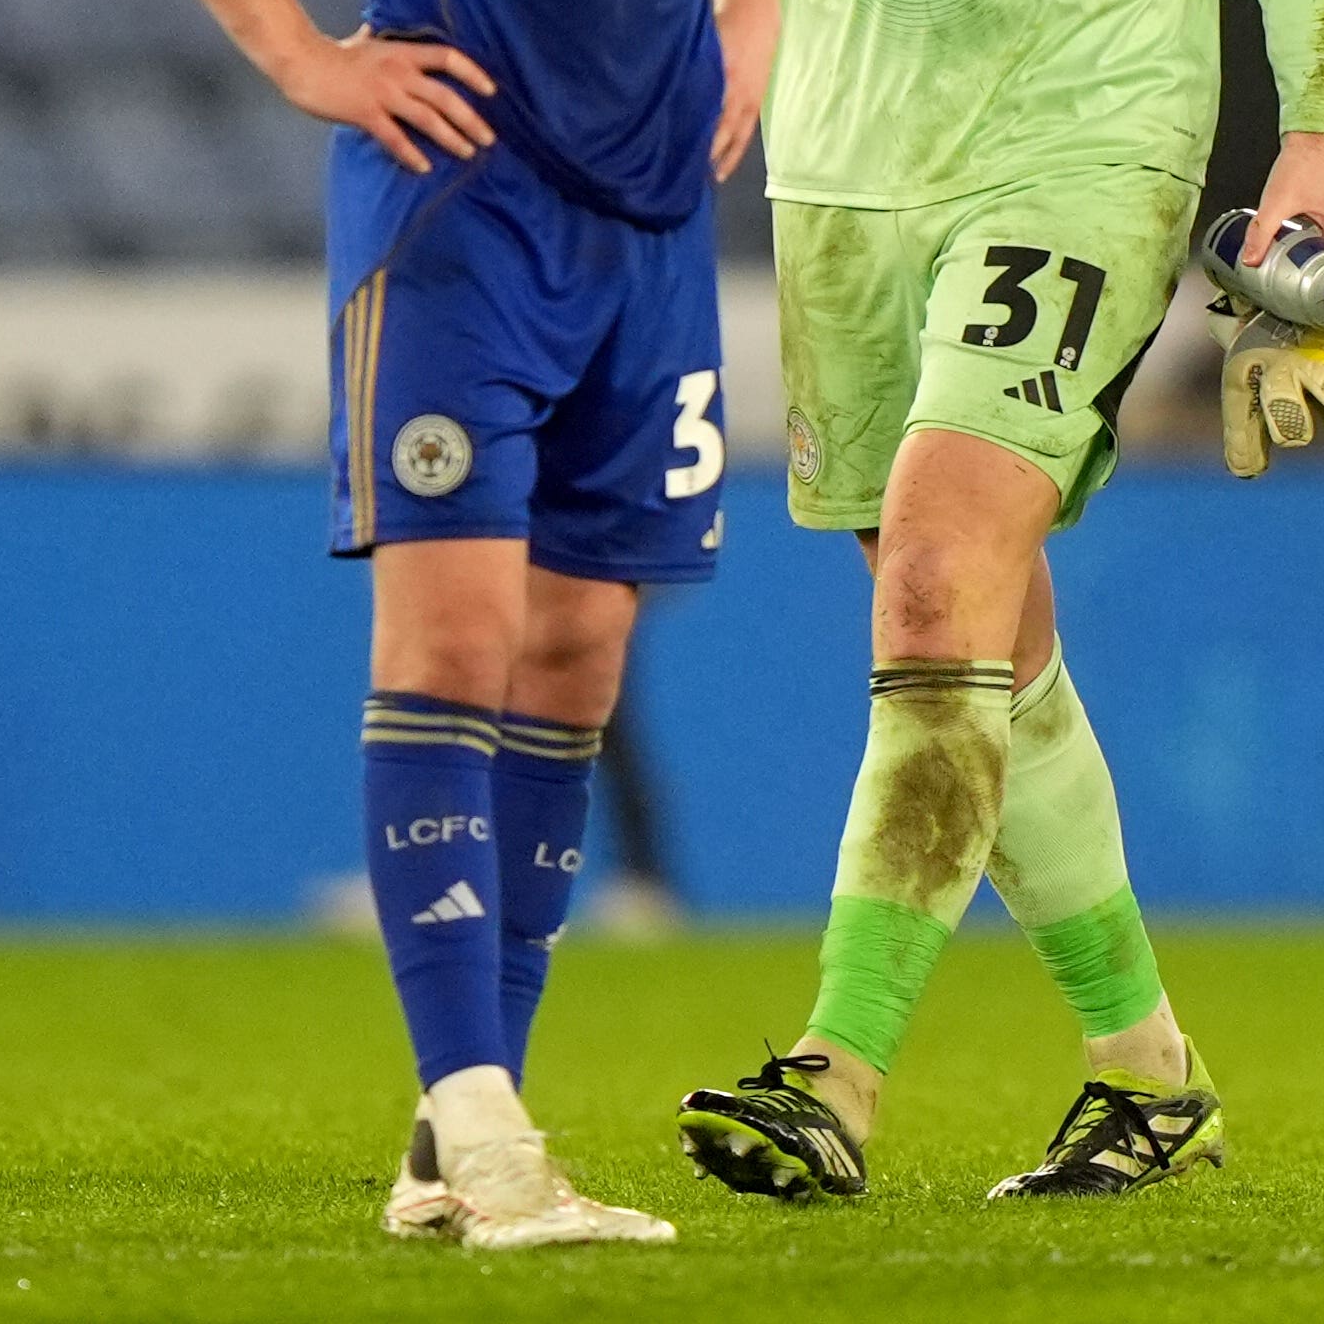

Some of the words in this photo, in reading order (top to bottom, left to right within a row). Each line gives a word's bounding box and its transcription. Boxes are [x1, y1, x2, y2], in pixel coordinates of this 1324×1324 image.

[961, 245, 1107, 372] 31
[385, 815, 491, 851] LCFC
[533, 841, 585, 873] LC
